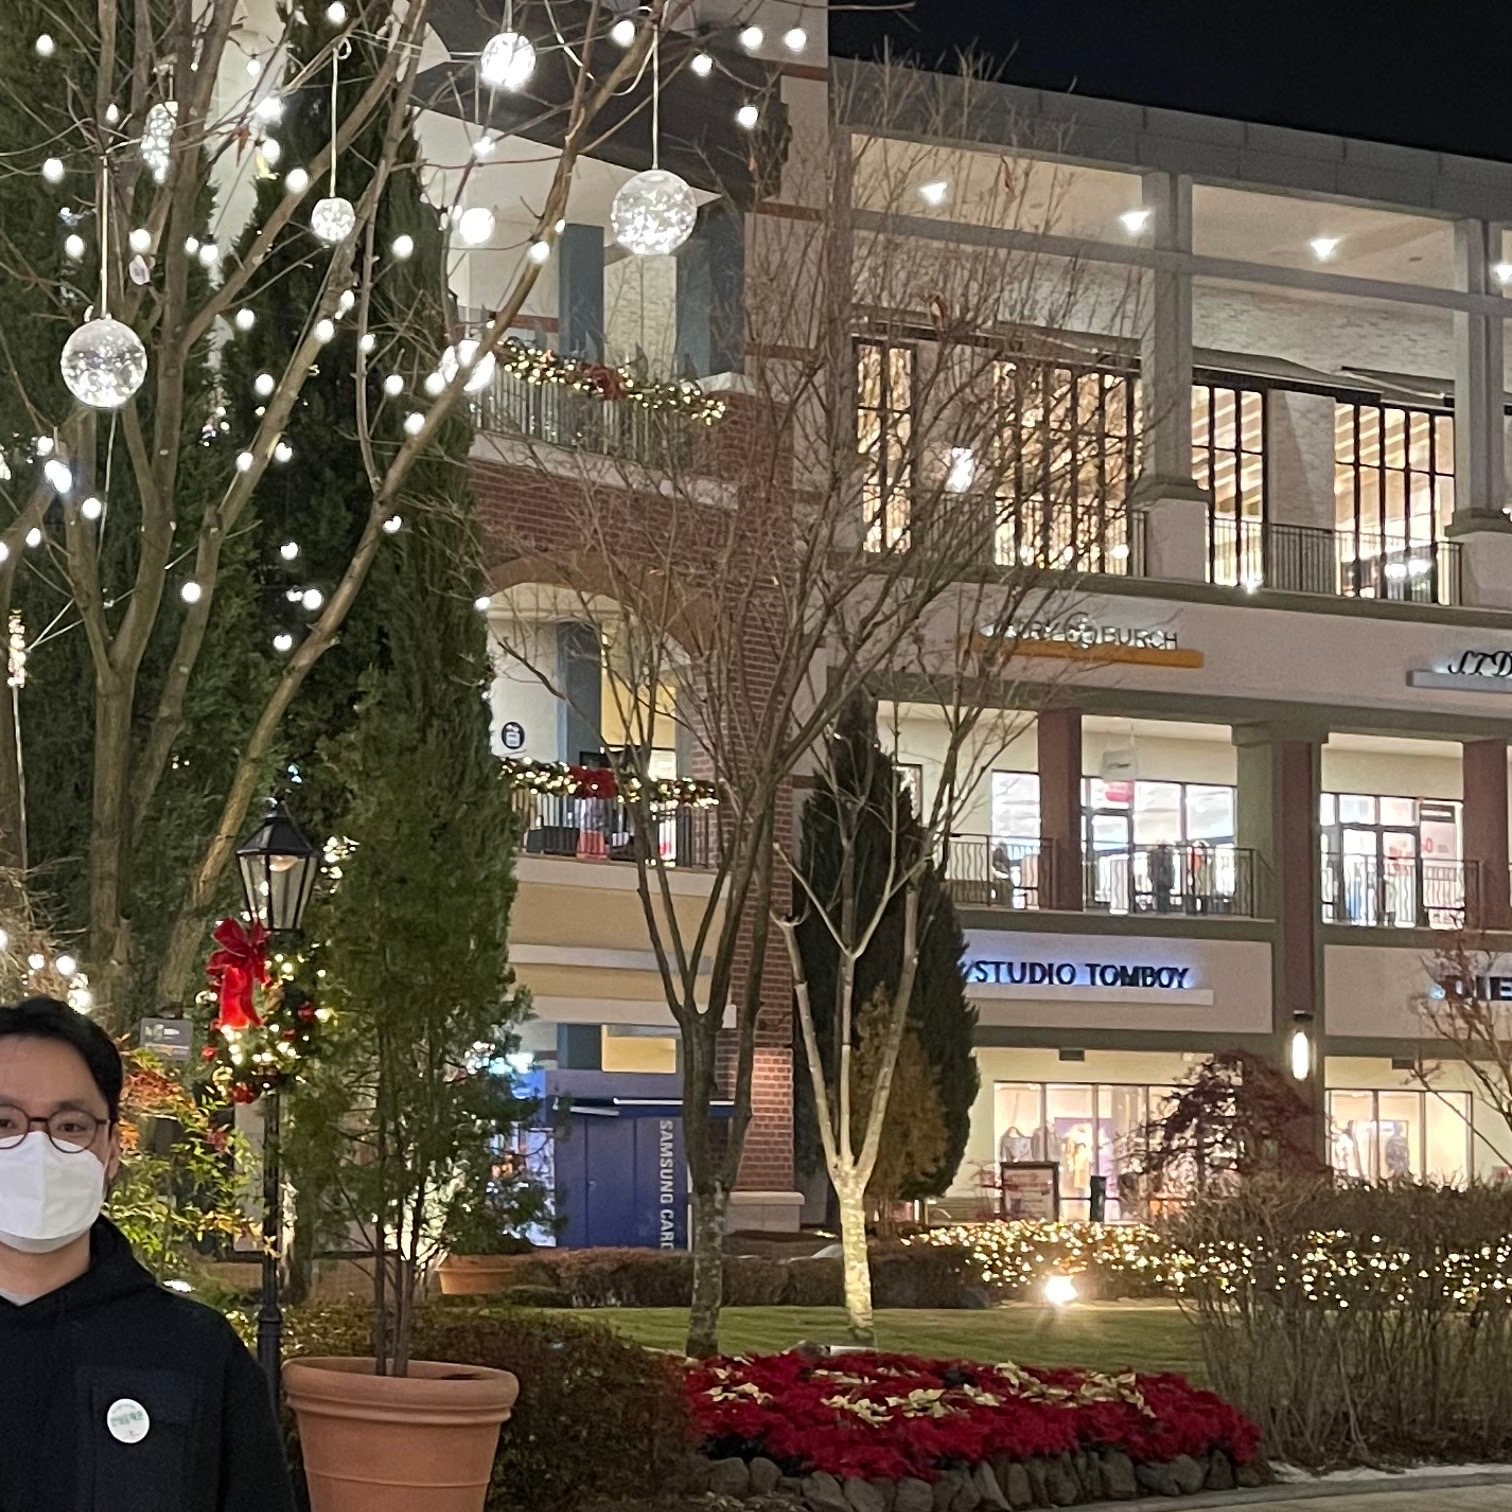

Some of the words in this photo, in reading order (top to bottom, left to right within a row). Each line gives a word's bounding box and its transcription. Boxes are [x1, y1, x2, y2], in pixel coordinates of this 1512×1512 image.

[1101, 626, 1178, 650] BURCH
[1084, 963, 1189, 988] TOMBOY
[659, 1119, 674, 1204] SAMSUNG
